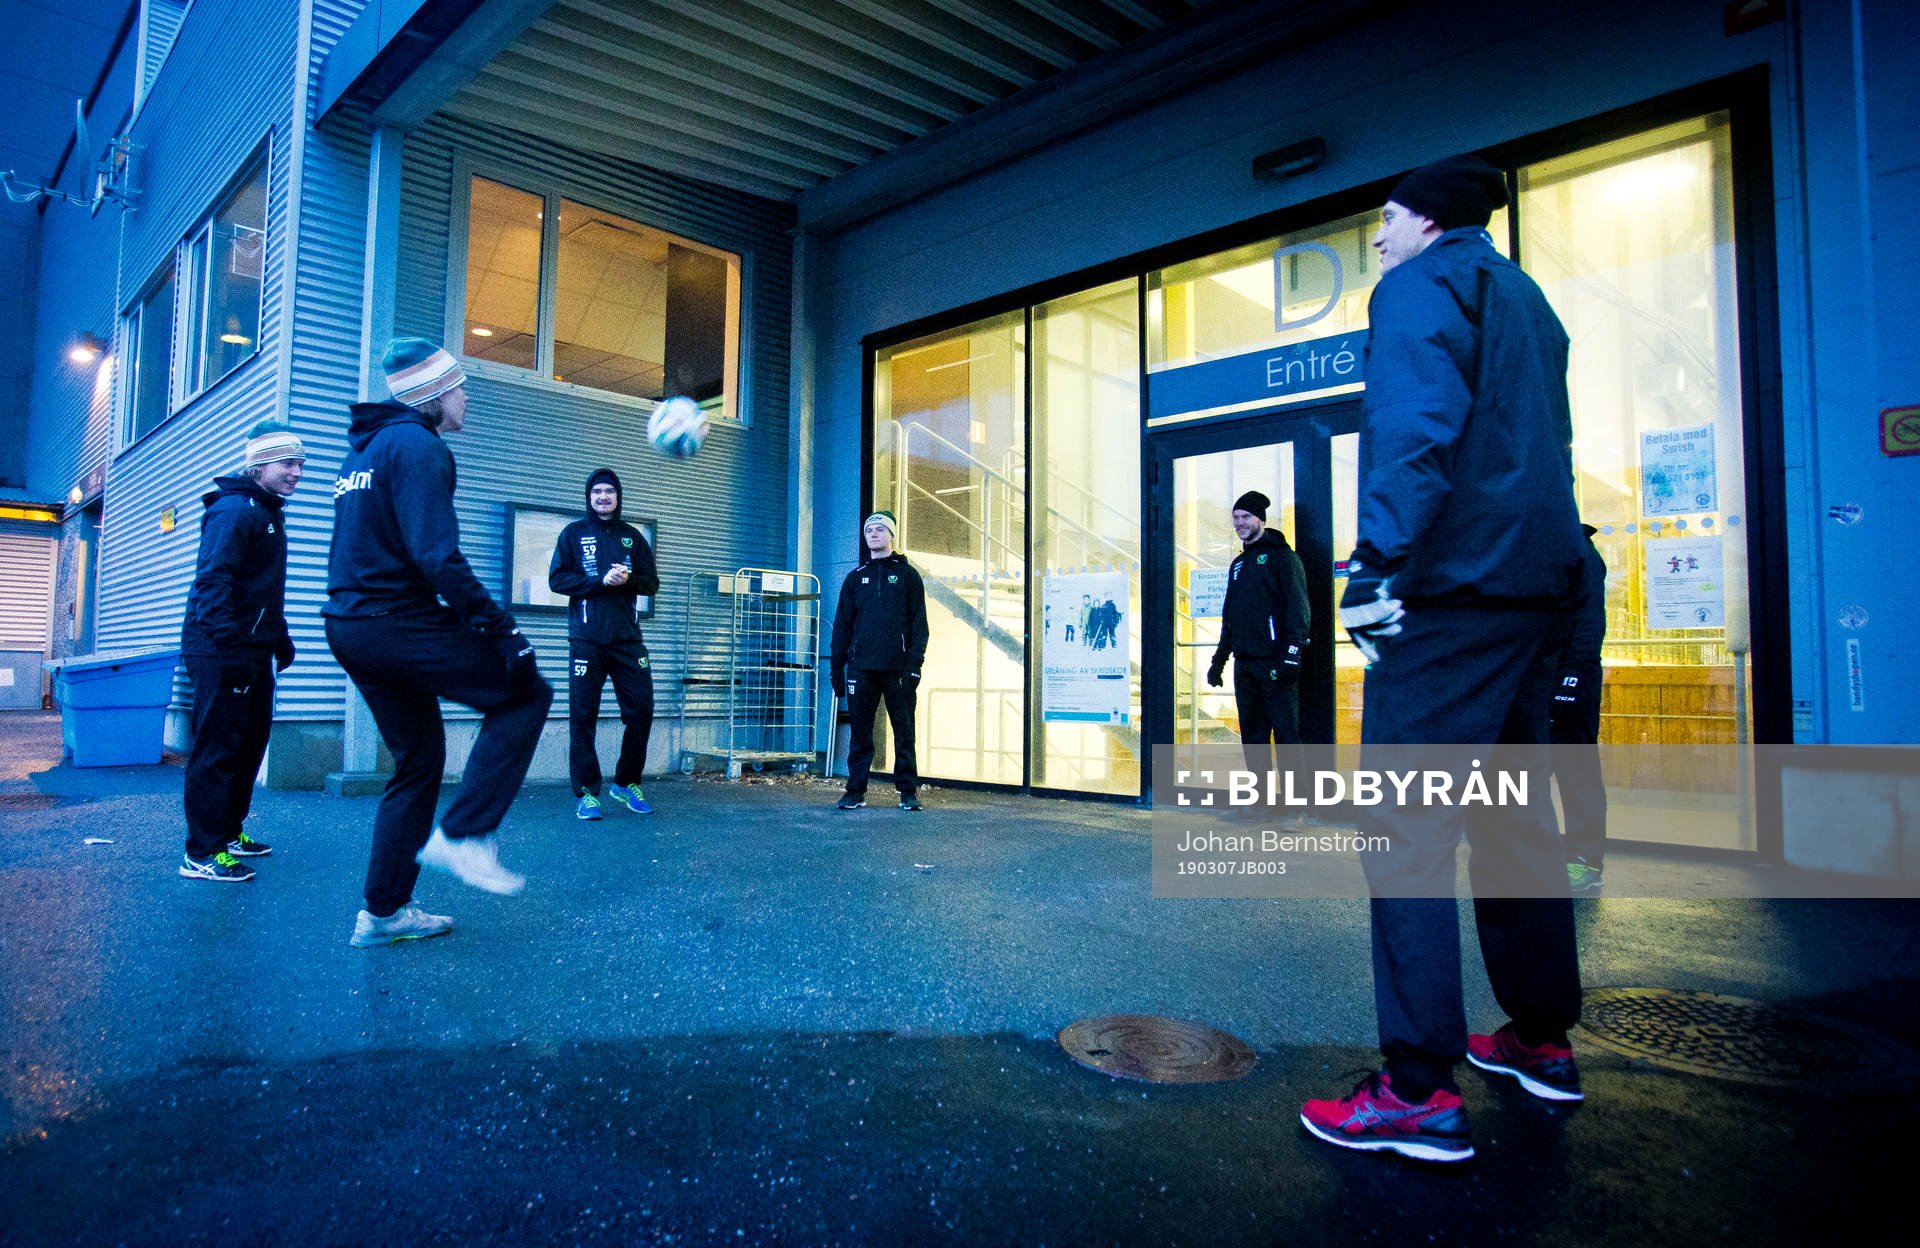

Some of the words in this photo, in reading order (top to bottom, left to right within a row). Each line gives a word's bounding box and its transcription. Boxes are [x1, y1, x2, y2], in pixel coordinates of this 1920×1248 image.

[1273, 242, 1343, 333] D
[1266, 341, 1355, 388] Entré
[1645, 432, 1680, 444] Betala
[1683, 428, 1707, 440] med
[1662, 442, 1694, 454] Swish
[582, 545, 597, 556] 59
[574, 665, 587, 676] 59
[1091, 667, 1127, 675] SKRIDSKOR
